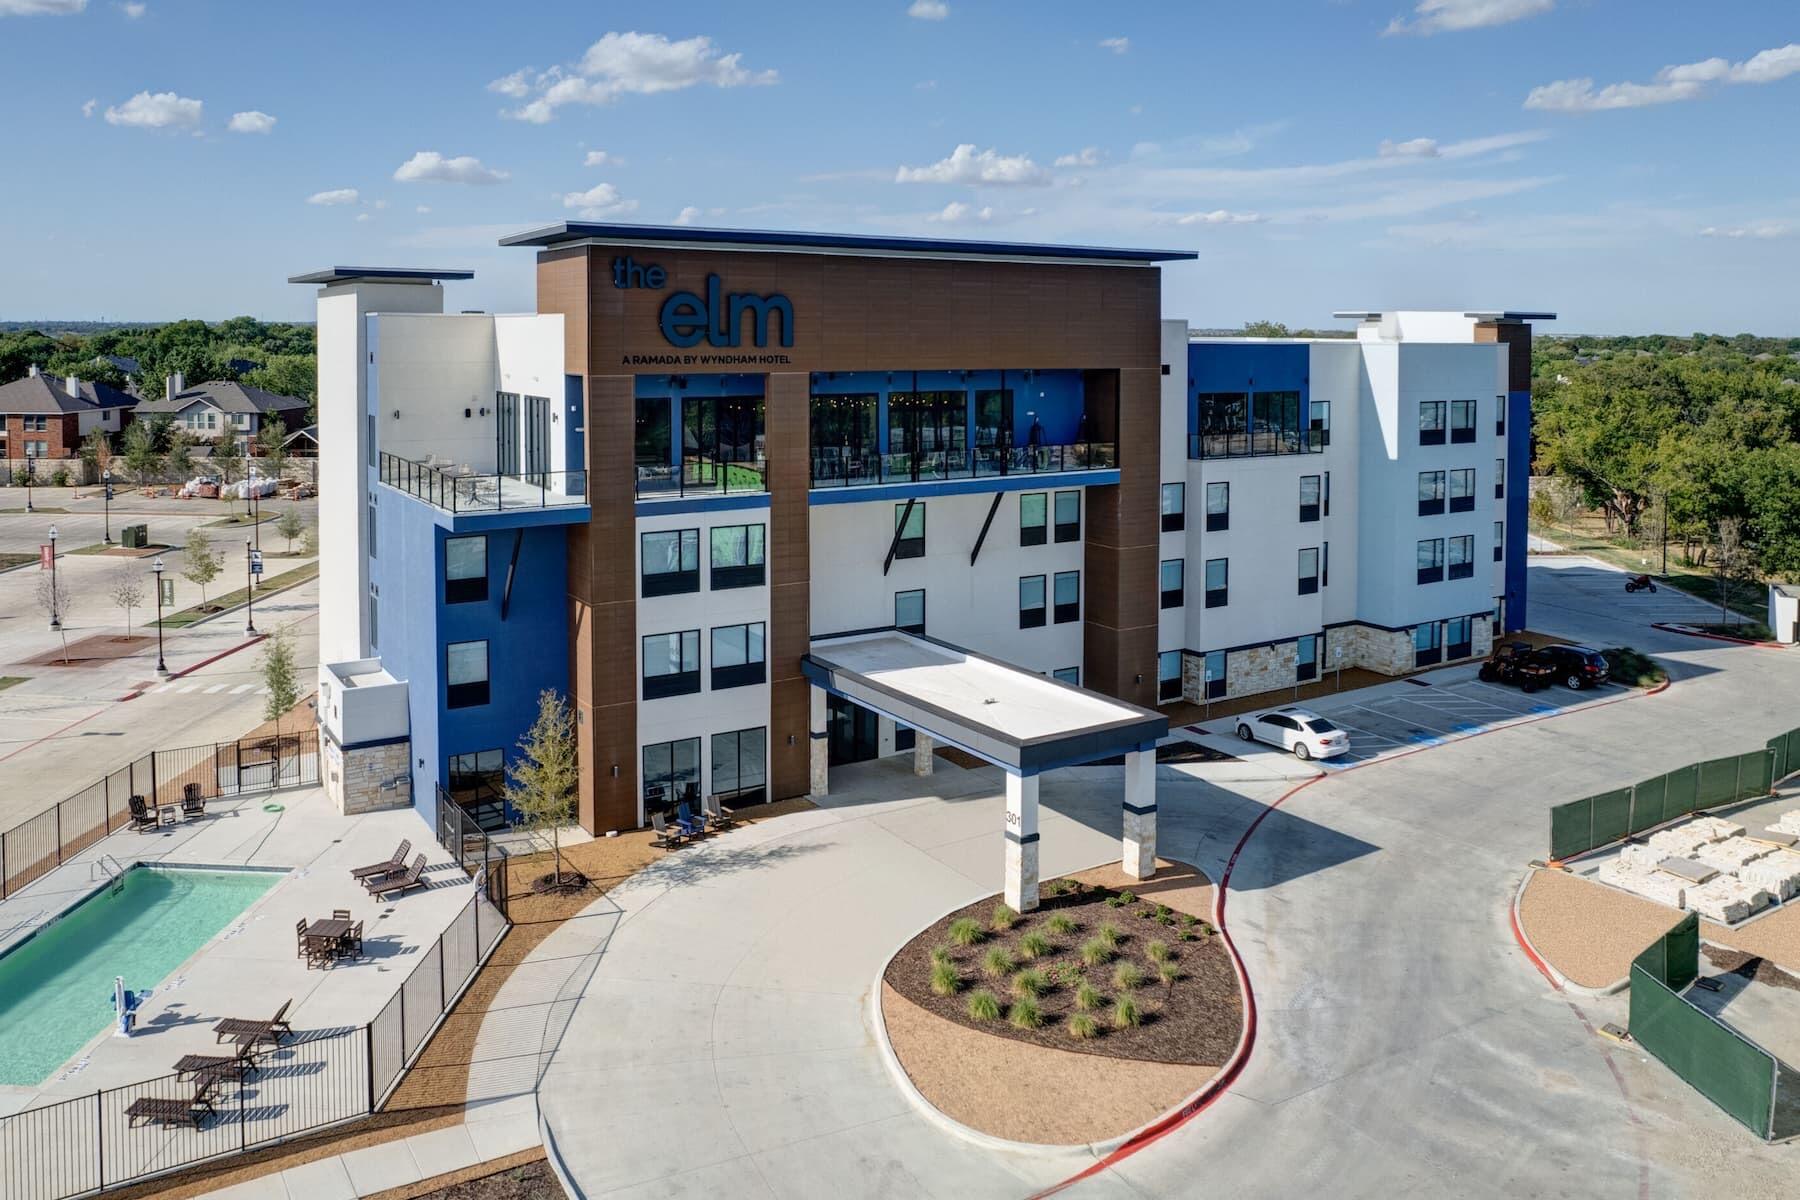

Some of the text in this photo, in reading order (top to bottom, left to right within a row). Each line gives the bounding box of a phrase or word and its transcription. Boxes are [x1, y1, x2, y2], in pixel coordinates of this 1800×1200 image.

[613, 256, 667, 289] the
[659, 273, 794, 348] elm
[622, 355, 791, 365] A RAMADA BY WYNDHAM HOTEL
[1005, 810, 1021, 828] 301
